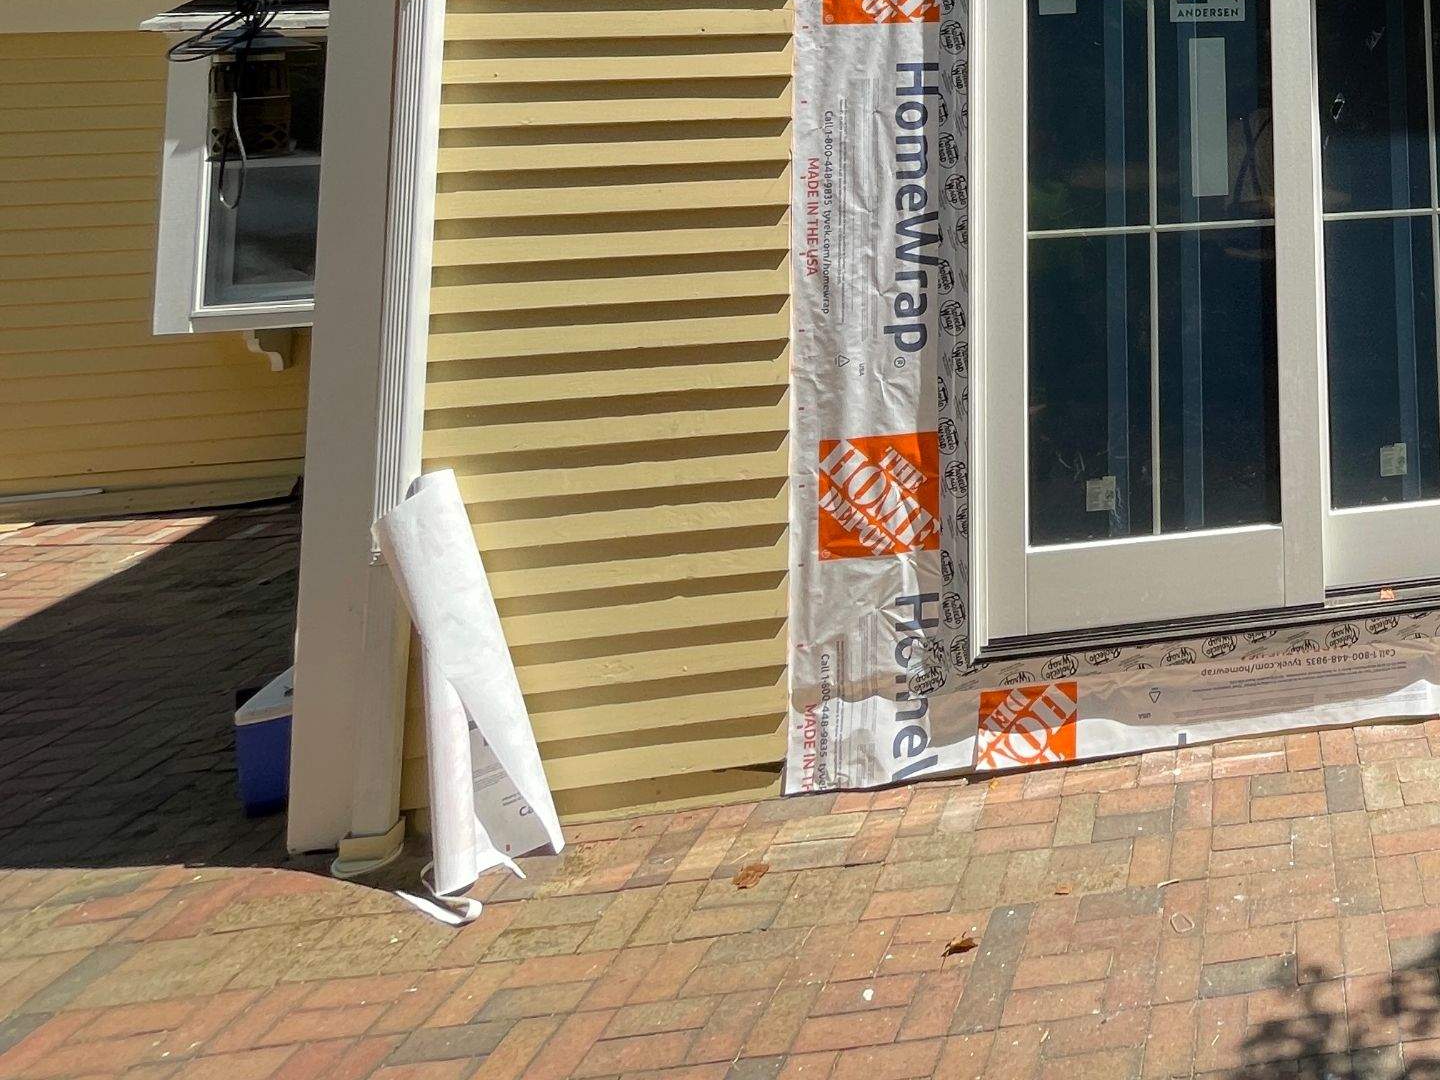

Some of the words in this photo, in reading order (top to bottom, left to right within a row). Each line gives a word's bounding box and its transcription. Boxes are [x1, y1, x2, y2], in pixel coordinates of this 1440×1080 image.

[1177, 7, 1240, 18] ANDERSEN
[823, 110, 833, 130] Call
[807, 158, 820, 196] MADE
[807, 199, 819, 215] IN
[884, 62, 940, 353] HomeWrap
[806, 217, 819, 245] THE
[806, 245, 818, 277] USA
[878, 447, 928, 495] THE
[819, 439, 942, 551] HOME
[819, 487, 897, 557] DEPOT
[820, 653, 830, 675] Call
[1380, 648, 1396, 657] Call
[804, 704, 817, 750] MADE
[803, 752, 816, 770] IN
